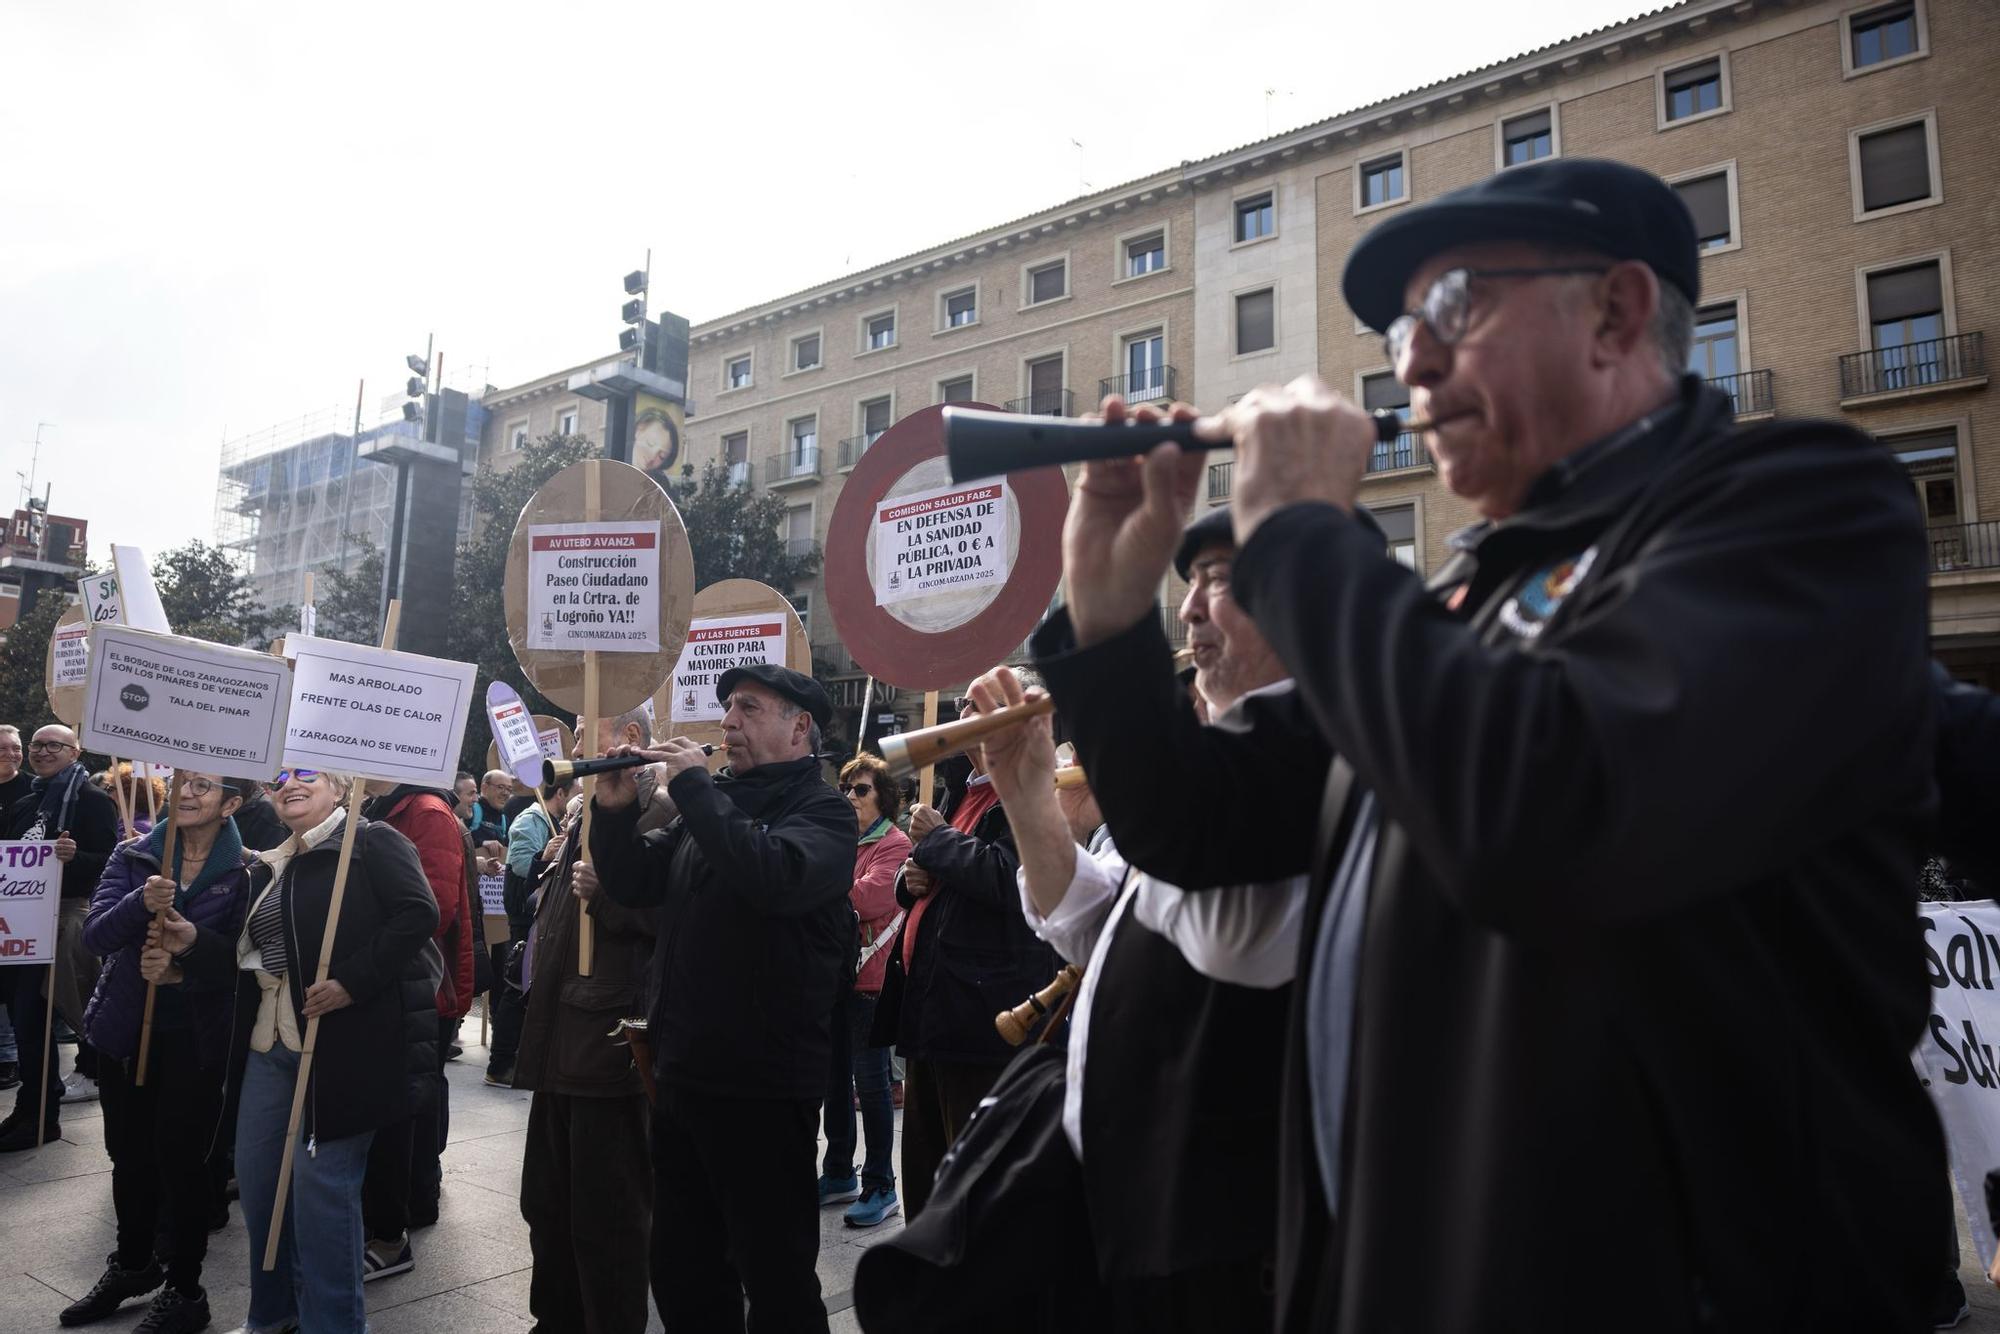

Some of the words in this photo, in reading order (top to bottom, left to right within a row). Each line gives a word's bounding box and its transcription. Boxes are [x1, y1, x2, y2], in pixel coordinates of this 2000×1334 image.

[889, 502, 932, 519] COMISIÓN
[934, 496, 965, 508] SALUD
[967, 489, 992, 502] FABZ
[897, 519, 912, 534] EN
[916, 507, 972, 529] DEFENSA
[976, 502, 995, 517] DE
[549, 539, 562, 549] AV
[563, 538, 592, 547] UTEBO
[593, 537, 636, 547] AVANZA
[908, 533, 922, 547] LA
[926, 521, 982, 543] SANIDAD
[897, 544, 953, 566] PÚBLICA,
[972, 537, 981, 551] €
[985, 535, 994, 548] A
[558, 554, 637, 569] Construcción
[908, 566, 922, 580] LA
[926, 555, 982, 576] PRIVADA
[546, 573, 579, 587] Paseo
[582, 573, 648, 587] Ciudadano
[918, 573, 974, 589] CINCOMARZADA
[976, 569, 994, 580] 2025
[553, 594, 566, 605] en
[569, 591, 579, 605] la
[583, 591, 621, 605] Crtra.
[625, 591, 640, 605] de
[556, 609, 604, 625] Logroño
[608, 610, 635, 624] YA!!
[567, 630, 626, 640] CINCOMARZADA
[628, 631, 647, 640] 2025
[695, 631, 706, 640] AV
[708, 630, 723, 639] LAS
[725, 627, 760, 638] FUENTES
[694, 643, 735, 656] CENTRO
[738, 640, 766, 653] PARA
[110, 652, 121, 661] EL
[124, 655, 160, 671] BOSQUE
[163, 666, 175, 674] DE
[176, 668, 195, 679] LOS
[197, 673, 269, 691] ZARAGOZANOS
[688, 657, 735, 671] MAYORES
[738, 655, 767, 668] ZONA
[111, 662, 132, 674] SON
[135, 668, 153, 679] LOS
[156, 673, 199, 689] PINARES
[202, 683, 215, 692] DE
[218, 686, 263, 699] VENECIA
[329, 672, 355, 684] MAS
[357, 677, 423, 696] ARBOLADO
[677, 673, 710, 687] NORTE
[121, 691, 148, 704] STOP
[169, 696, 194, 708] TALA
[196, 702, 215, 712] DEL
[218, 706, 250, 717] PINAR
[301, 693, 348, 708] FRENTE
[350, 701, 382, 713] OLAS
[385, 706, 400, 716] DE
[403, 709, 442, 722] CALOR
[102, 723, 109, 731] !!
[111, 725, 171, 745] ZARAGOZA
[173, 739, 189, 749] NO
[191, 742, 206, 752] SE
[209, 745, 246, 758] VENDE
[249, 751, 257, 759] !!
[290, 728, 297, 737] !!
[299, 729, 358, 746] ZARAGOZA
[360, 739, 375, 748] NO
[378, 742, 391, 751] SE
[394, 744, 428, 756] VENDE
[430, 749, 437, 757] !!
[0, 845, 53, 868] TOP
[0, 938, 36, 957] NDE
